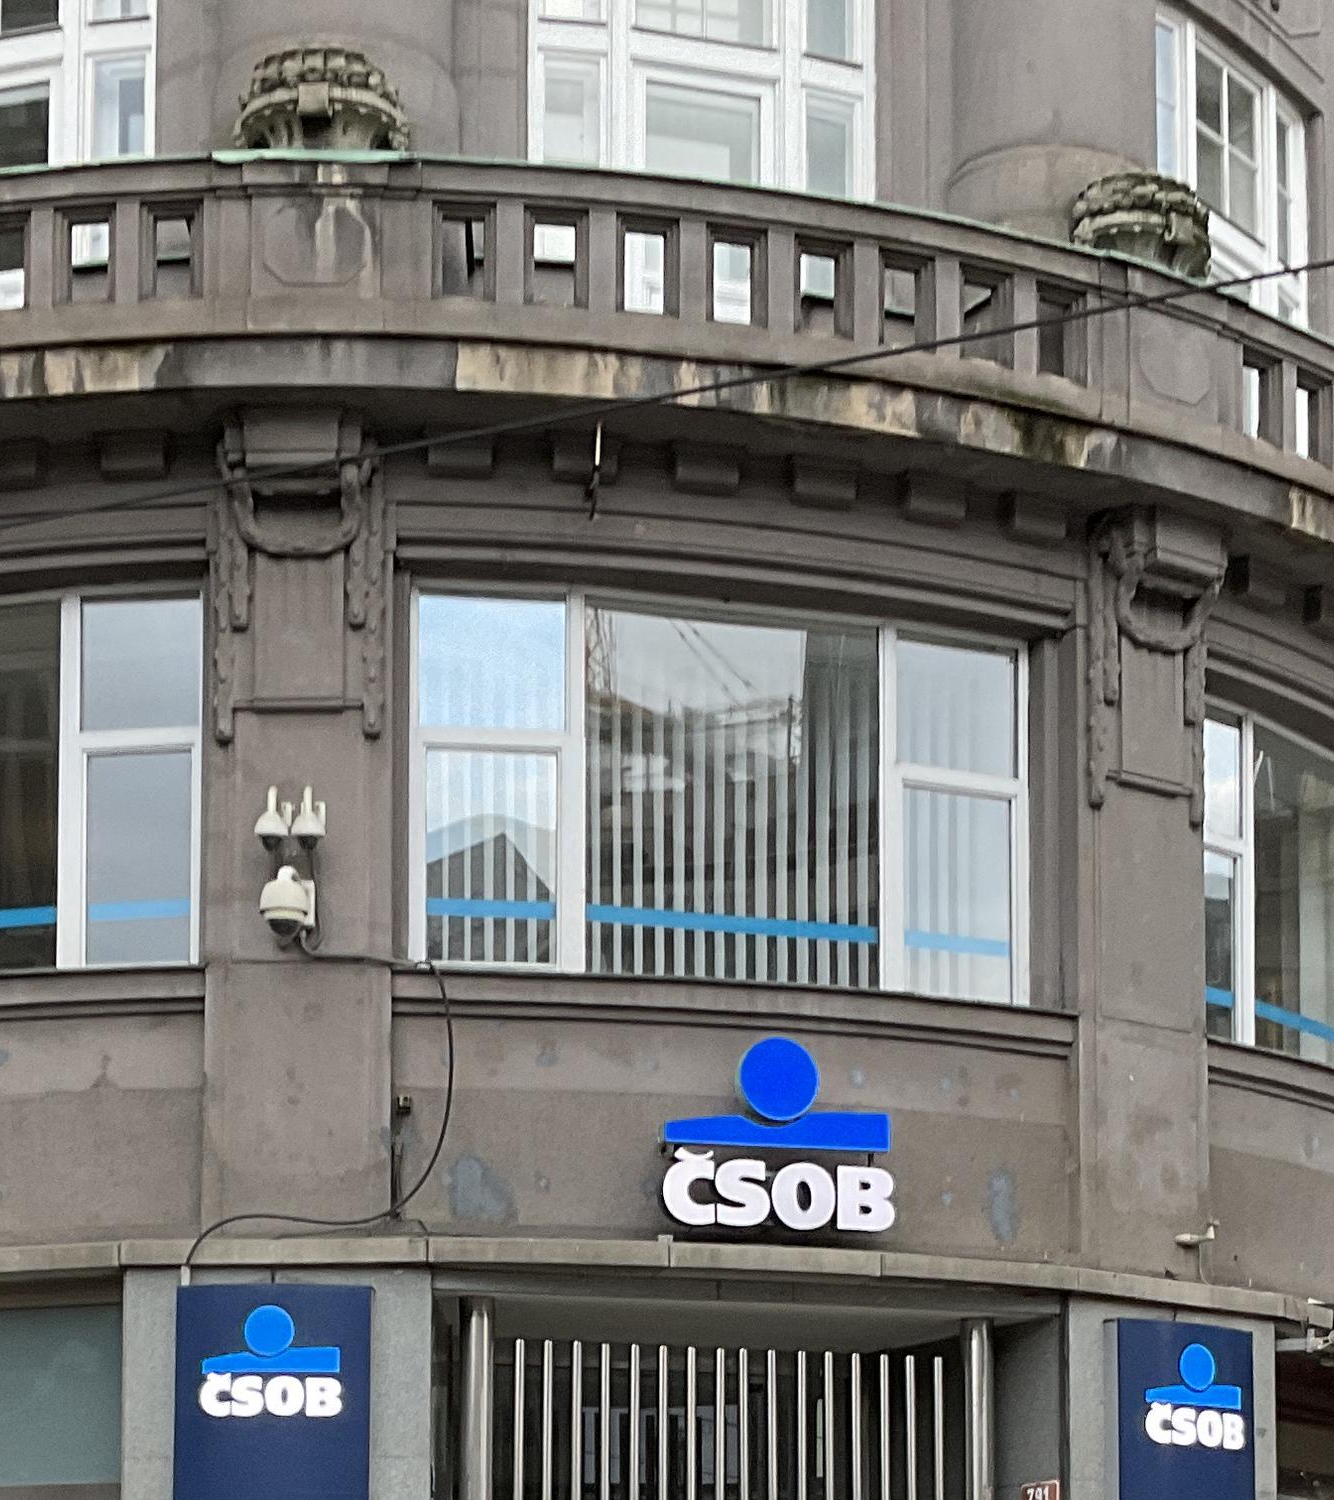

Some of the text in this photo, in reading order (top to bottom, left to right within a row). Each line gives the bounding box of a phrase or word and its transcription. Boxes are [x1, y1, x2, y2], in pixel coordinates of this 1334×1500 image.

[663, 1147, 896, 1232] ČSOB
[200, 1373, 343, 1417] ČSOB
[1145, 1402, 1244, 1450] ČSOB
